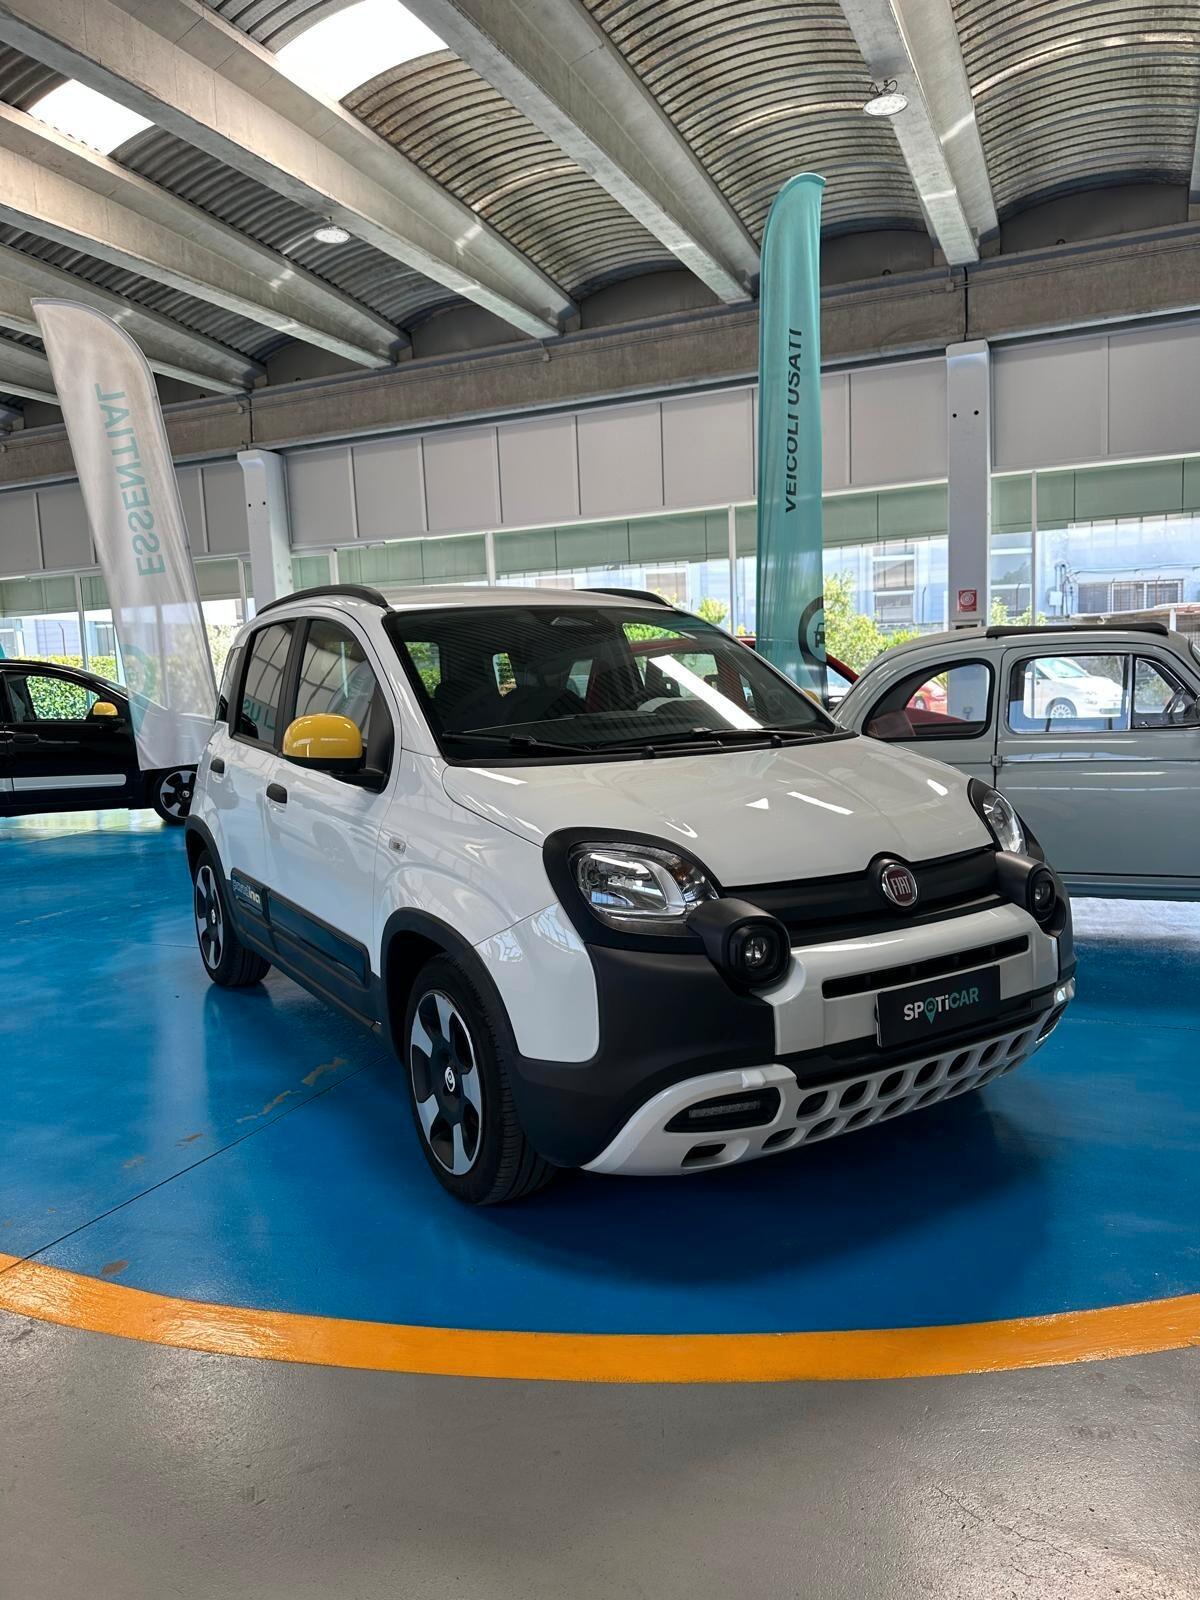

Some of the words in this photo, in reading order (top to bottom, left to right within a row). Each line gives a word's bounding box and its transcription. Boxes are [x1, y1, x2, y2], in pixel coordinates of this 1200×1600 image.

[787, 328, 802, 406] USATI
[785, 413, 799, 513] VEICOLI
[890, 875, 911, 896] FIAT
